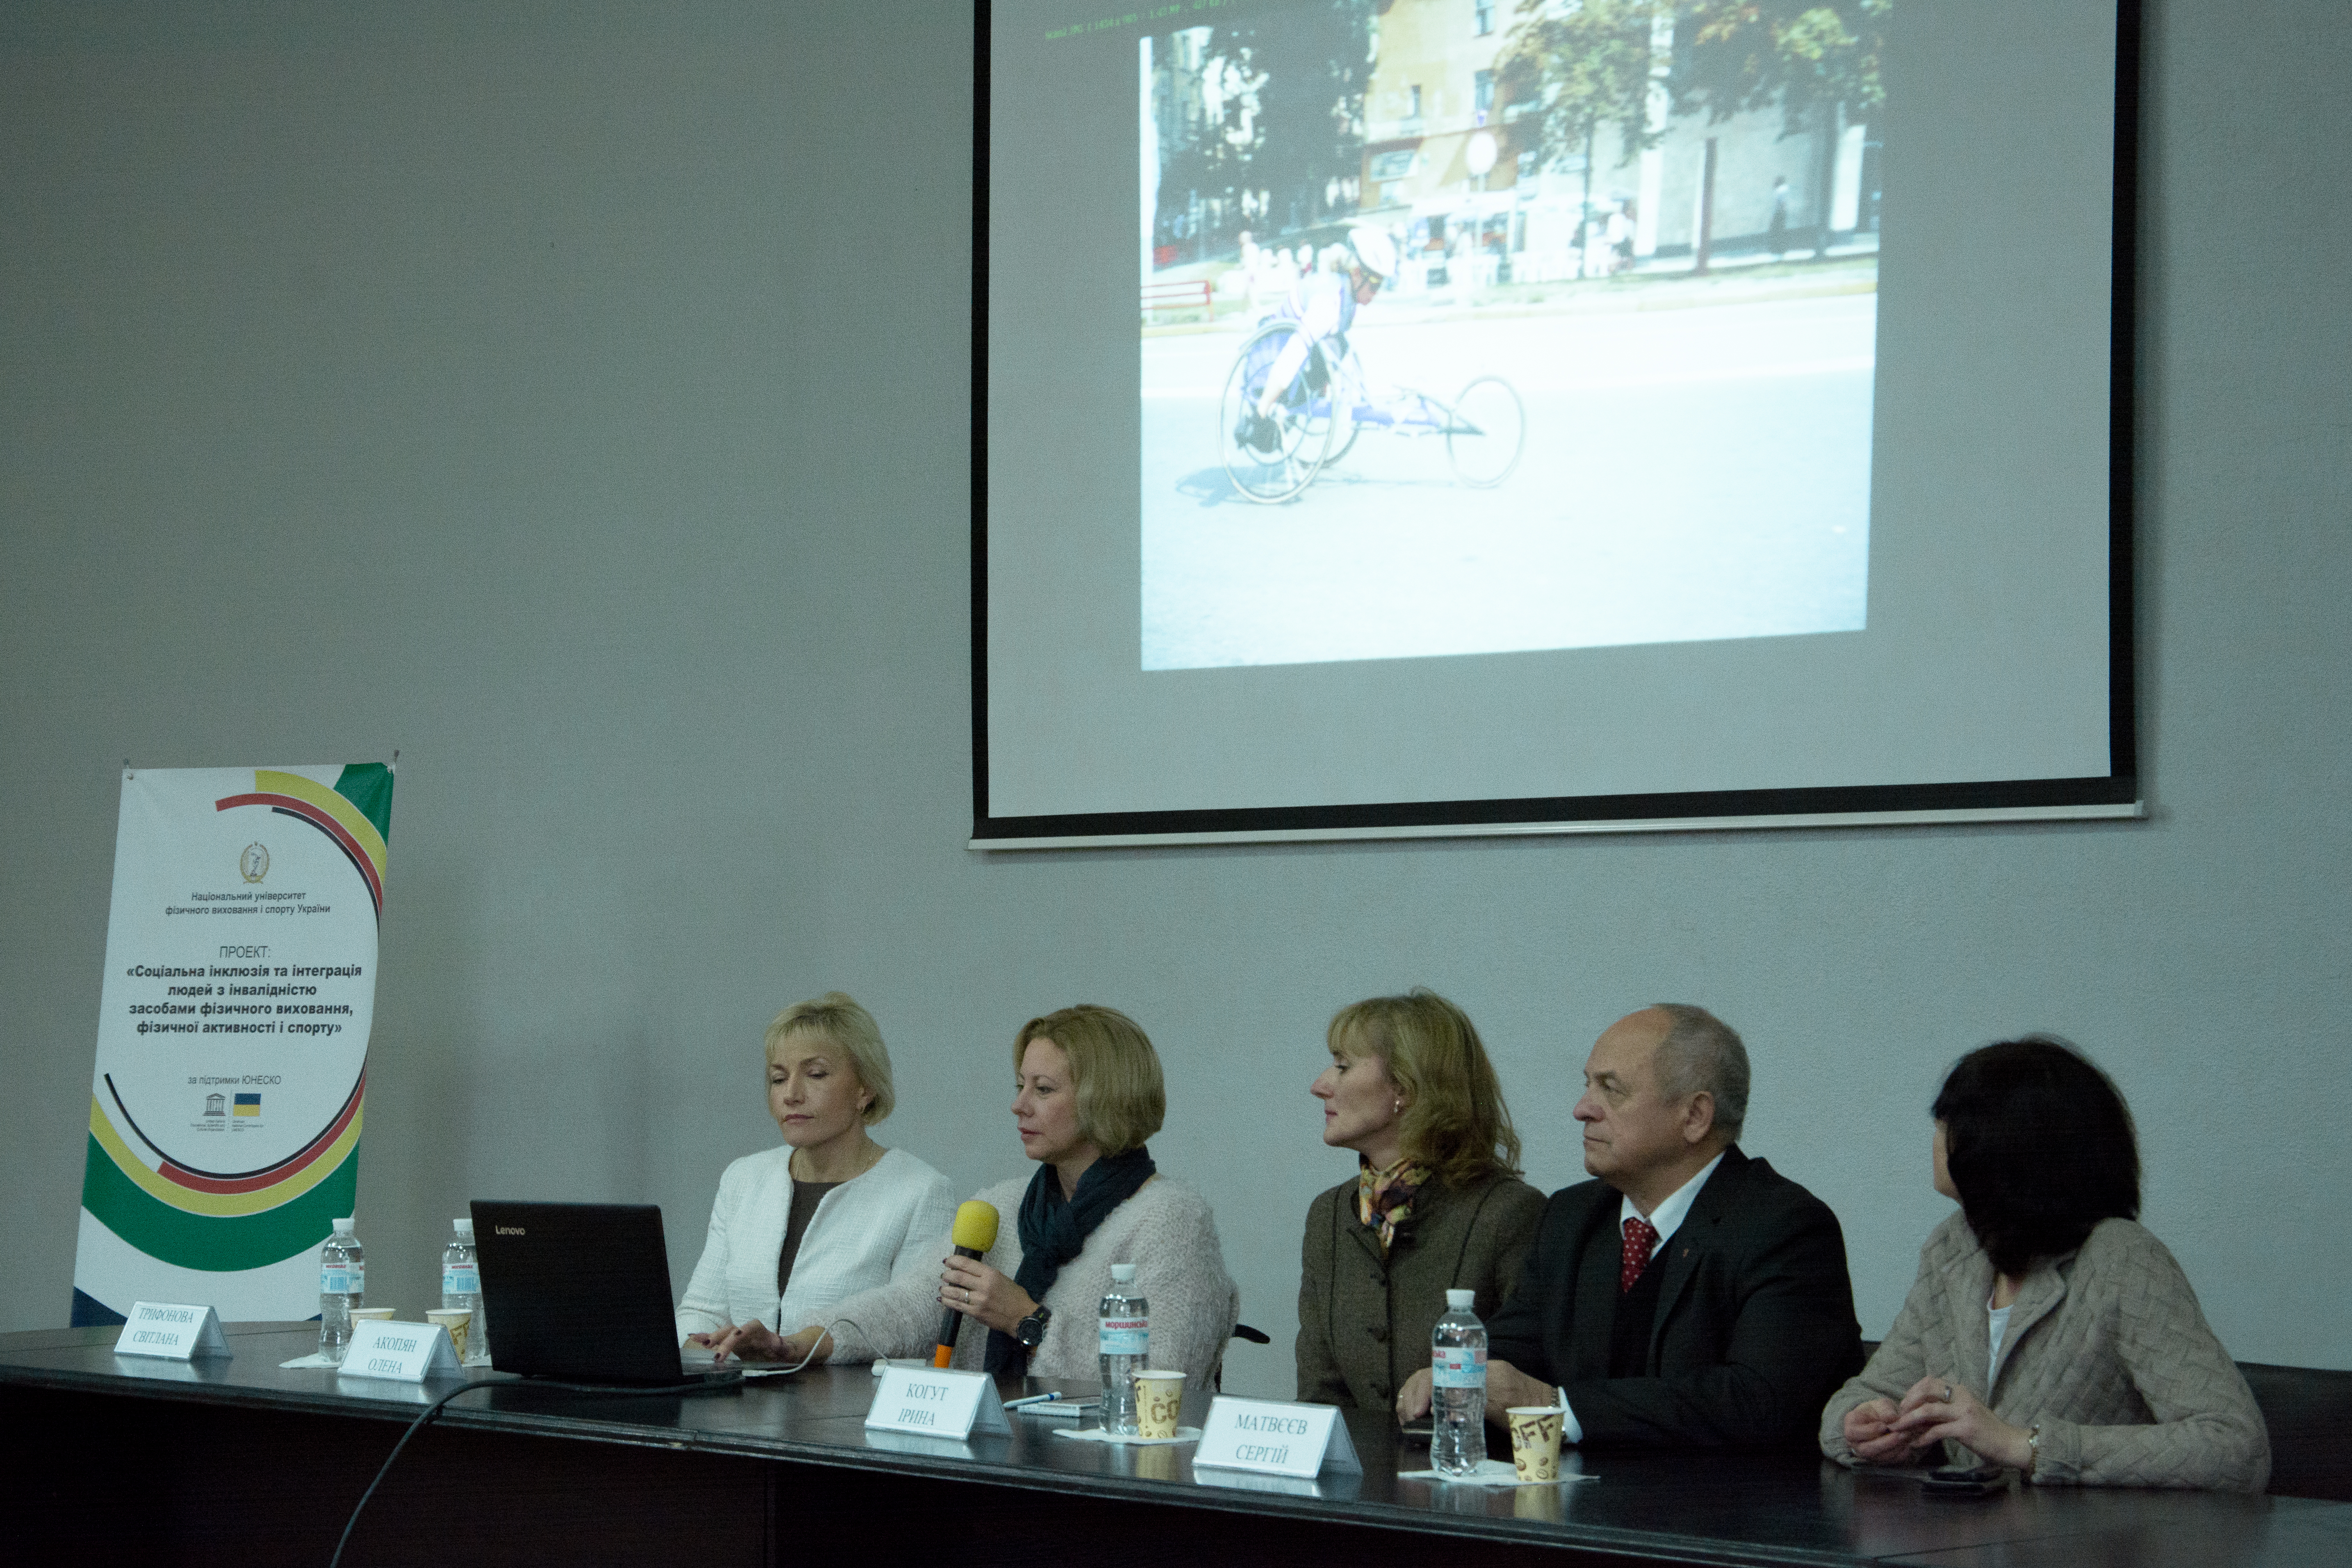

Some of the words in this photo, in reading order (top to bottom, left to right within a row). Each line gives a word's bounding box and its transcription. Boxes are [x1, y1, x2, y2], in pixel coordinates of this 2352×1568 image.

[191, 891, 252, 903] Національний
[255, 891, 306, 902] університет
[165, 906, 209, 916] фізичного
[265, 905, 294, 916] спорту
[298, 904, 330, 913] України
[219, 946, 271, 958] ПРОЕКТ:
[126, 964, 205, 979] «Соціальна
[209, 965, 269, 977] інклюзія
[273, 967, 288, 977] та
[292, 964, 362, 979] інтеграція
[167, 983, 212, 998] людей
[217, 987, 225, 996] з
[229, 983, 317, 998] інвалідністю
[129, 1002, 196, 1014] засобами
[200, 1002, 272, 1017] фізичного
[276, 1004, 353, 1016] виховання,
[137, 1020, 200, 1036] фізичної
[203, 1021, 275, 1033] активності
[279, 1021, 283, 1033] і
[288, 1023, 342, 1036] спорту»
[199, 1075, 239, 1086] підтримки
[242, 1075, 281, 1085] ЮНЕСКО
[495, 1225, 526, 1235] Lenovo
[139, 1307, 194, 1323] ТРИФОНОВА
[133, 1330, 179, 1346] СВІТЛАНА
[372, 1336, 417, 1352] АКОПЯН
[368, 1358, 402, 1374] ОЛЕНА
[906, 1383, 949, 1401] КОГУТ
[898, 1408, 935, 1426] ІРИНА
[1234, 1414, 1308, 1435] МАТВЄЄВ
[1235, 1444, 1289, 1464] СЕРГІЙ
